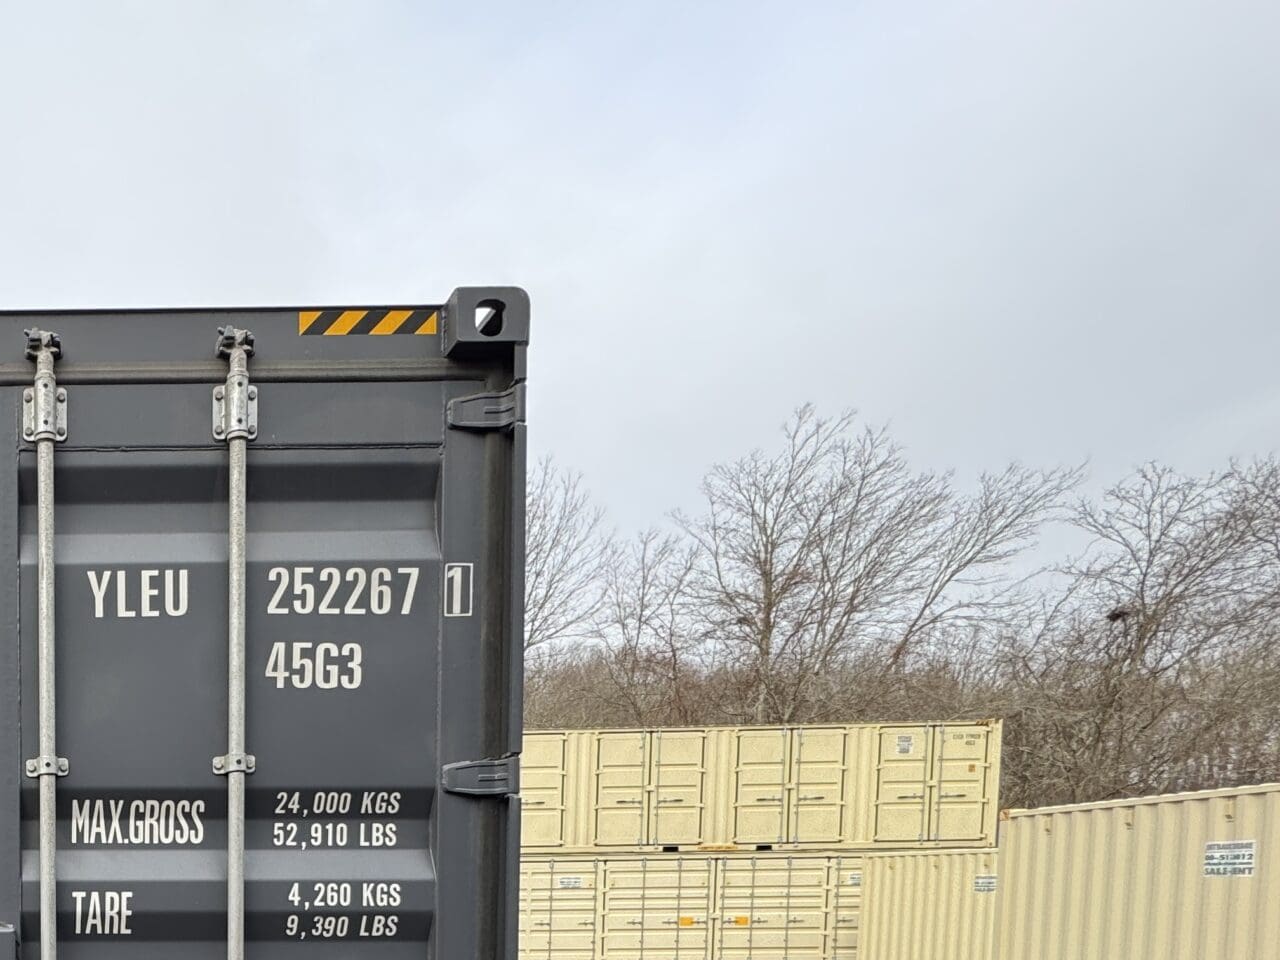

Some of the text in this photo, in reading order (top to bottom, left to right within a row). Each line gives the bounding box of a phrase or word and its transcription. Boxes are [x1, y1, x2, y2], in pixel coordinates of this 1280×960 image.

[86, 565, 465, 618] YLEU 252267 1
[264, 641, 363, 689] 45G3
[71, 799, 206, 845] MAX.GROSS
[274, 791, 402, 818] 24,000 KGS
[273, 822, 397, 850] 52,910 LBS
[71, 890, 134, 935] TARE
[288, 882, 402, 910] 4,260 KGS
[285, 914, 399, 940] 9,390 LBS
